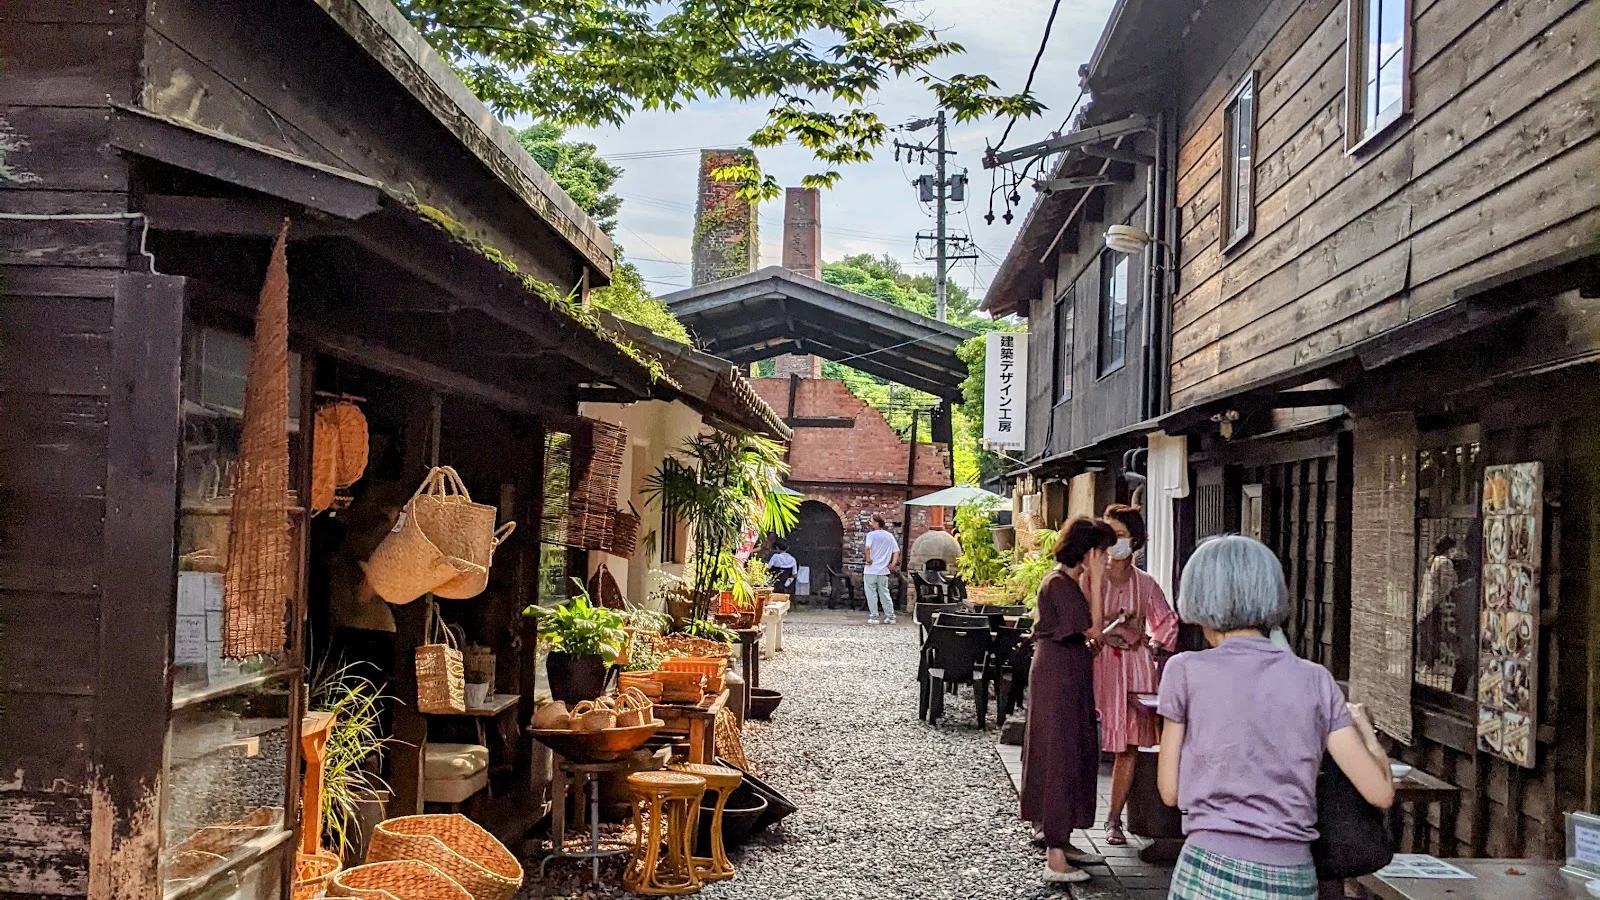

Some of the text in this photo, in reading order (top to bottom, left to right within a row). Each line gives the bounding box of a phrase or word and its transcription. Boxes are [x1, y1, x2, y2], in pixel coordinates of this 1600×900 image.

[998, 336, 1014, 432] 建築デザイン工房
